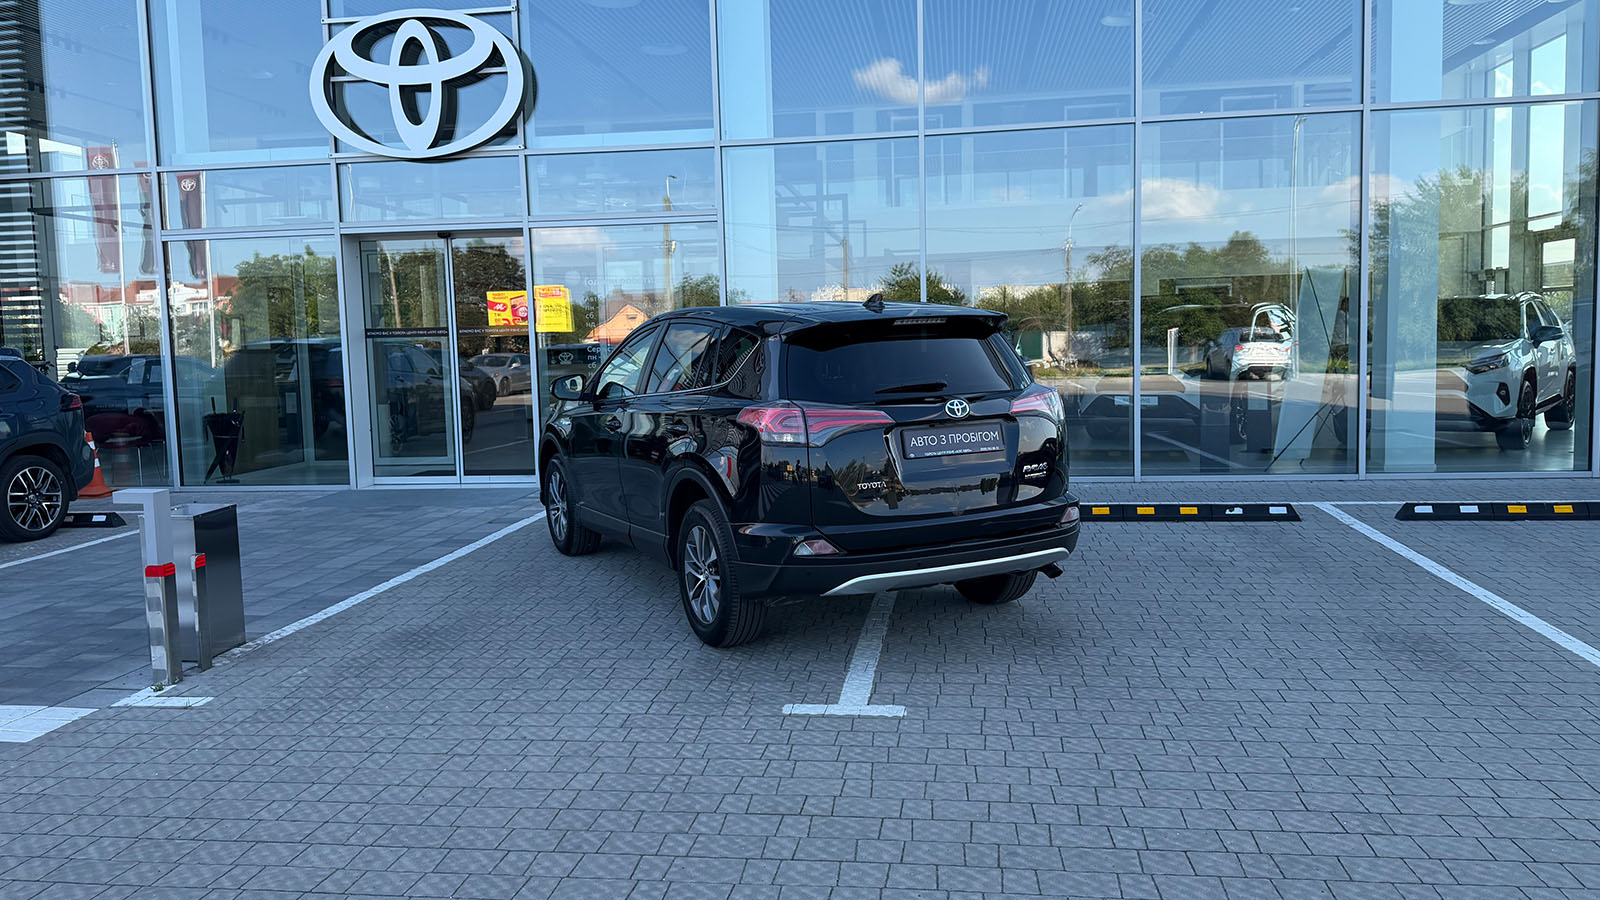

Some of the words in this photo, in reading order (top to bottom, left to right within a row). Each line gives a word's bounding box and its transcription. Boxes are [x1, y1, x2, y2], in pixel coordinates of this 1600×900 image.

[910, 435, 938, 447] АВТО
[948, 431, 1000, 444] ПРОБІГОМ
[857, 481, 887, 490] TOYOTA
